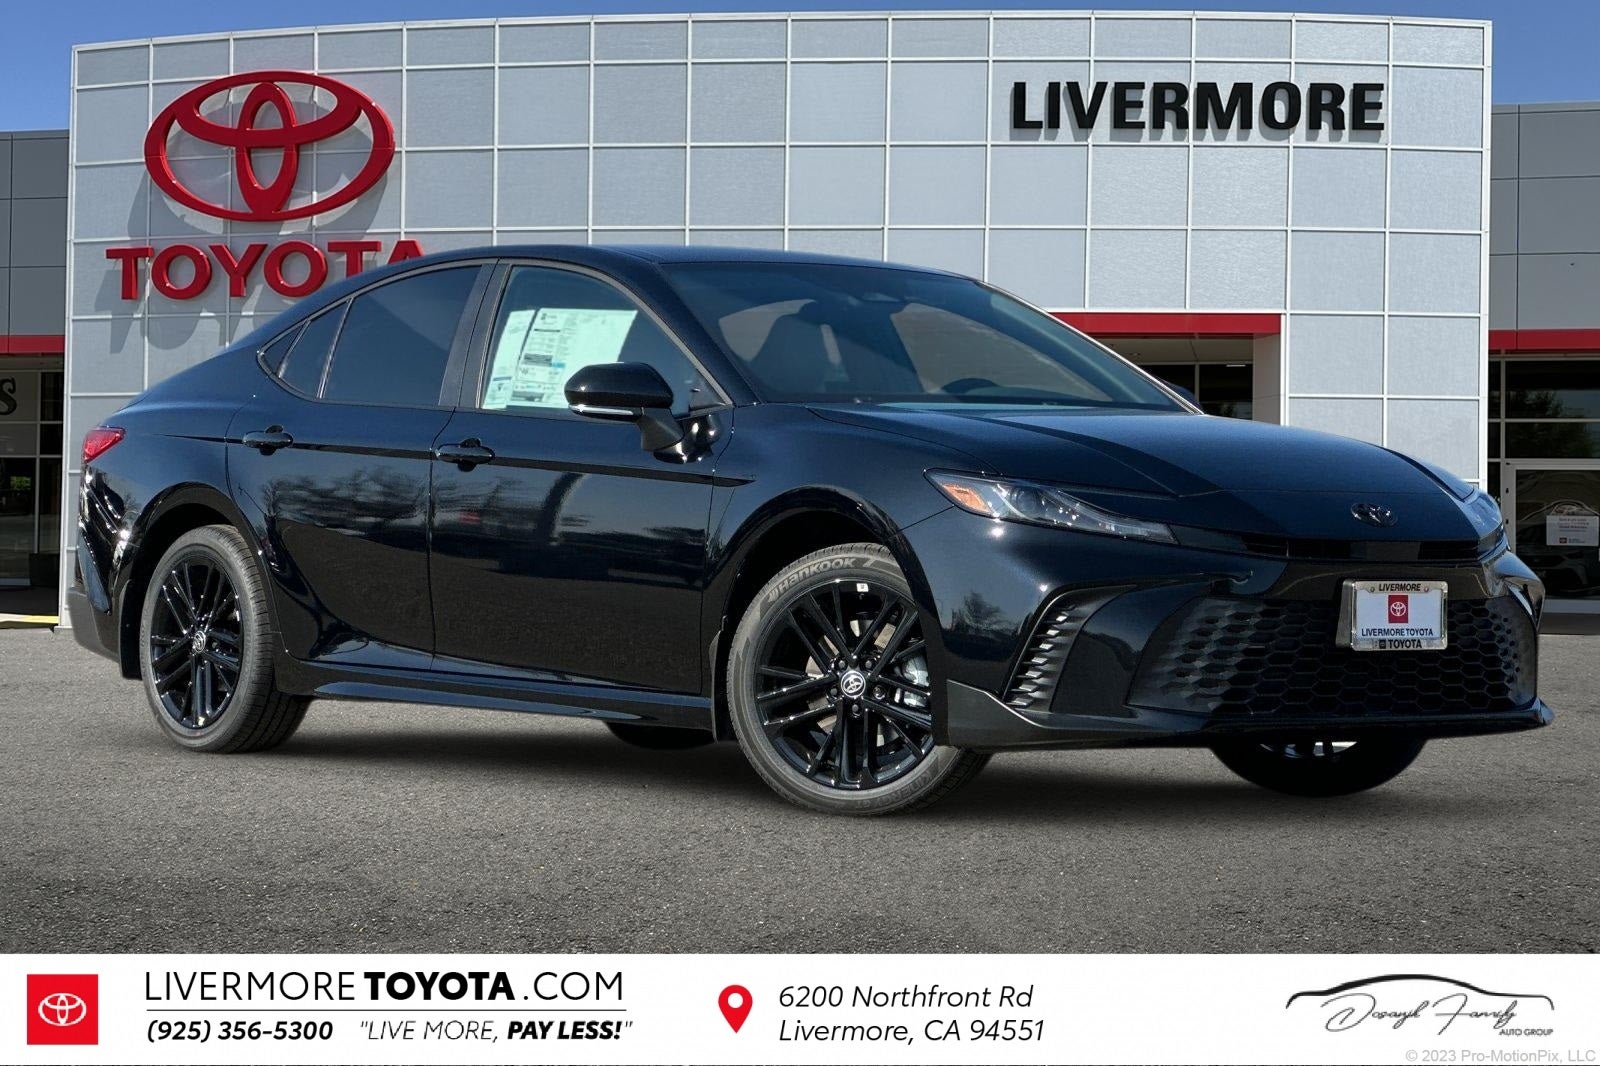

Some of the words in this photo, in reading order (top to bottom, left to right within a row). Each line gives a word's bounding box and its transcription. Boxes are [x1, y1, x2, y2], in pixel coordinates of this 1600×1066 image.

[1012, 81, 1386, 131] LIVERMORE
[1378, 583, 1421, 592] LIVERMORE
[1361, 628, 1404, 637] LIVERMORE
[1406, 628, 1434, 637] TOYOTA
[1388, 639, 1422, 648] TOYOTA
